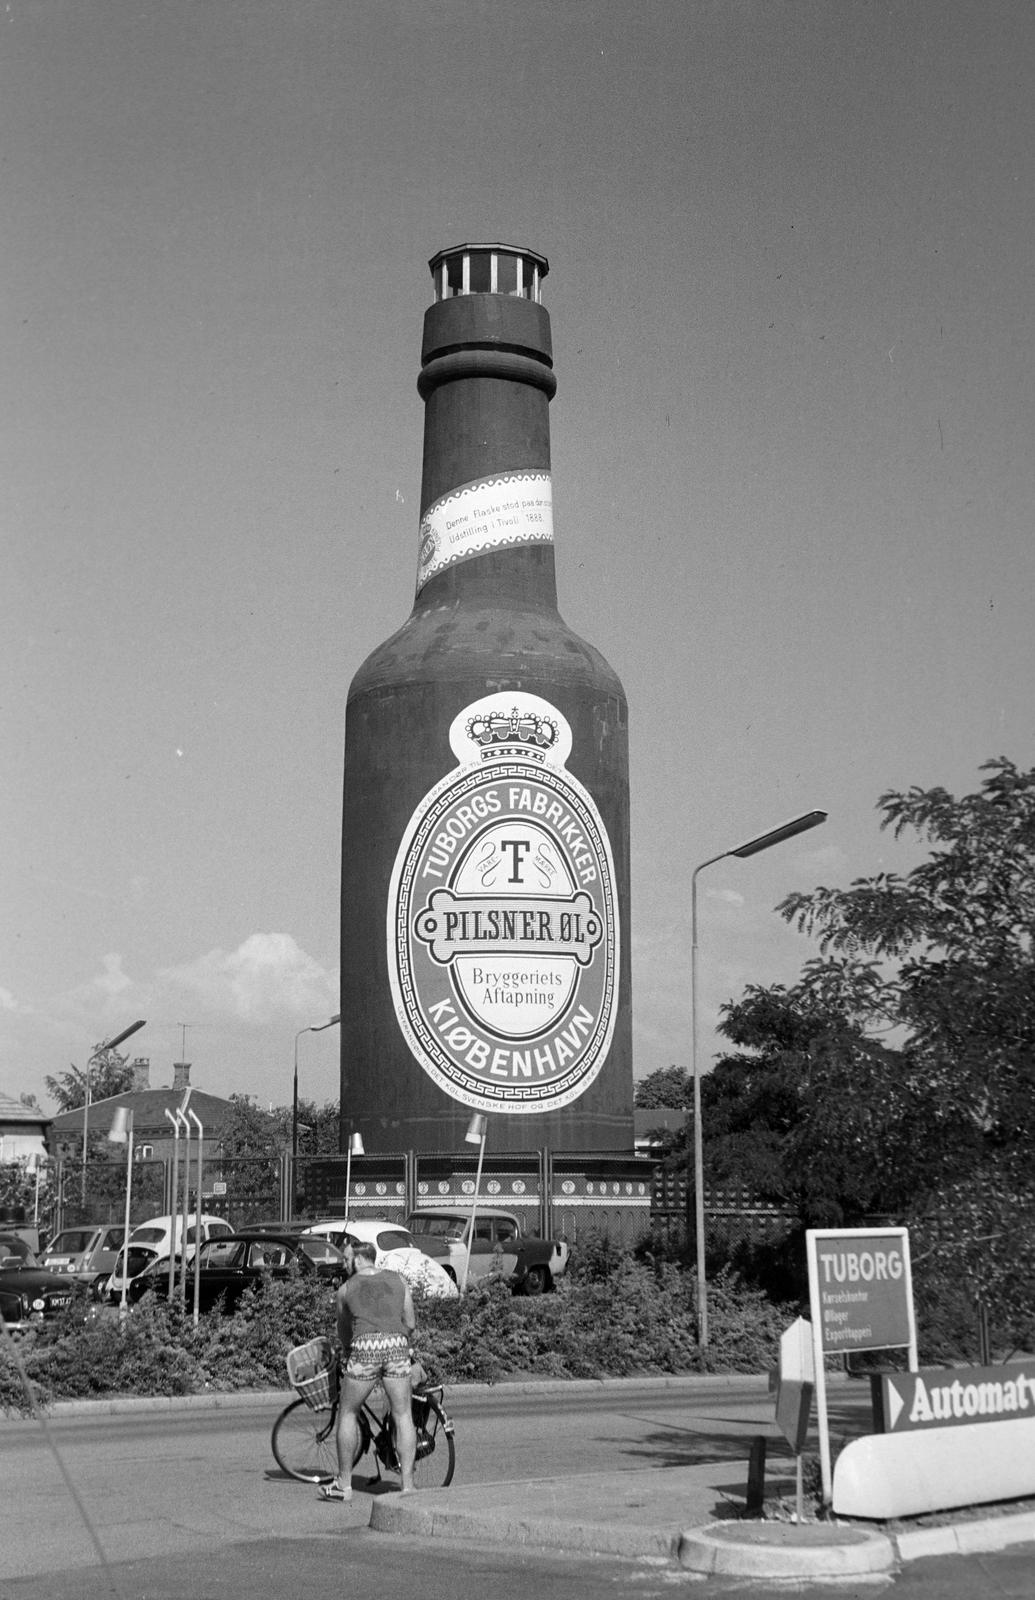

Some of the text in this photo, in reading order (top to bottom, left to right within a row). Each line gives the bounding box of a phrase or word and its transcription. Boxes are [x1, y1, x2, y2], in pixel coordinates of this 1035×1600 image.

[446, 516, 468, 530] Denne
[474, 505, 500, 518] Flaske
[449, 525, 488, 543] Udstilling
[497, 517, 519, 527] Tivoli
[422, 787, 597, 885] TUBORGS FABRIKKER
[444, 910, 586, 943] PILSNER ØL
[472, 967, 563, 988] Bryggeriets
[482, 988, 555, 1009] Aftapning
[428, 998, 595, 1077] KIØBENHAVN
[463, 1094, 505, 1109] SVENSKE
[820, 1250, 902, 1282] TUBORG
